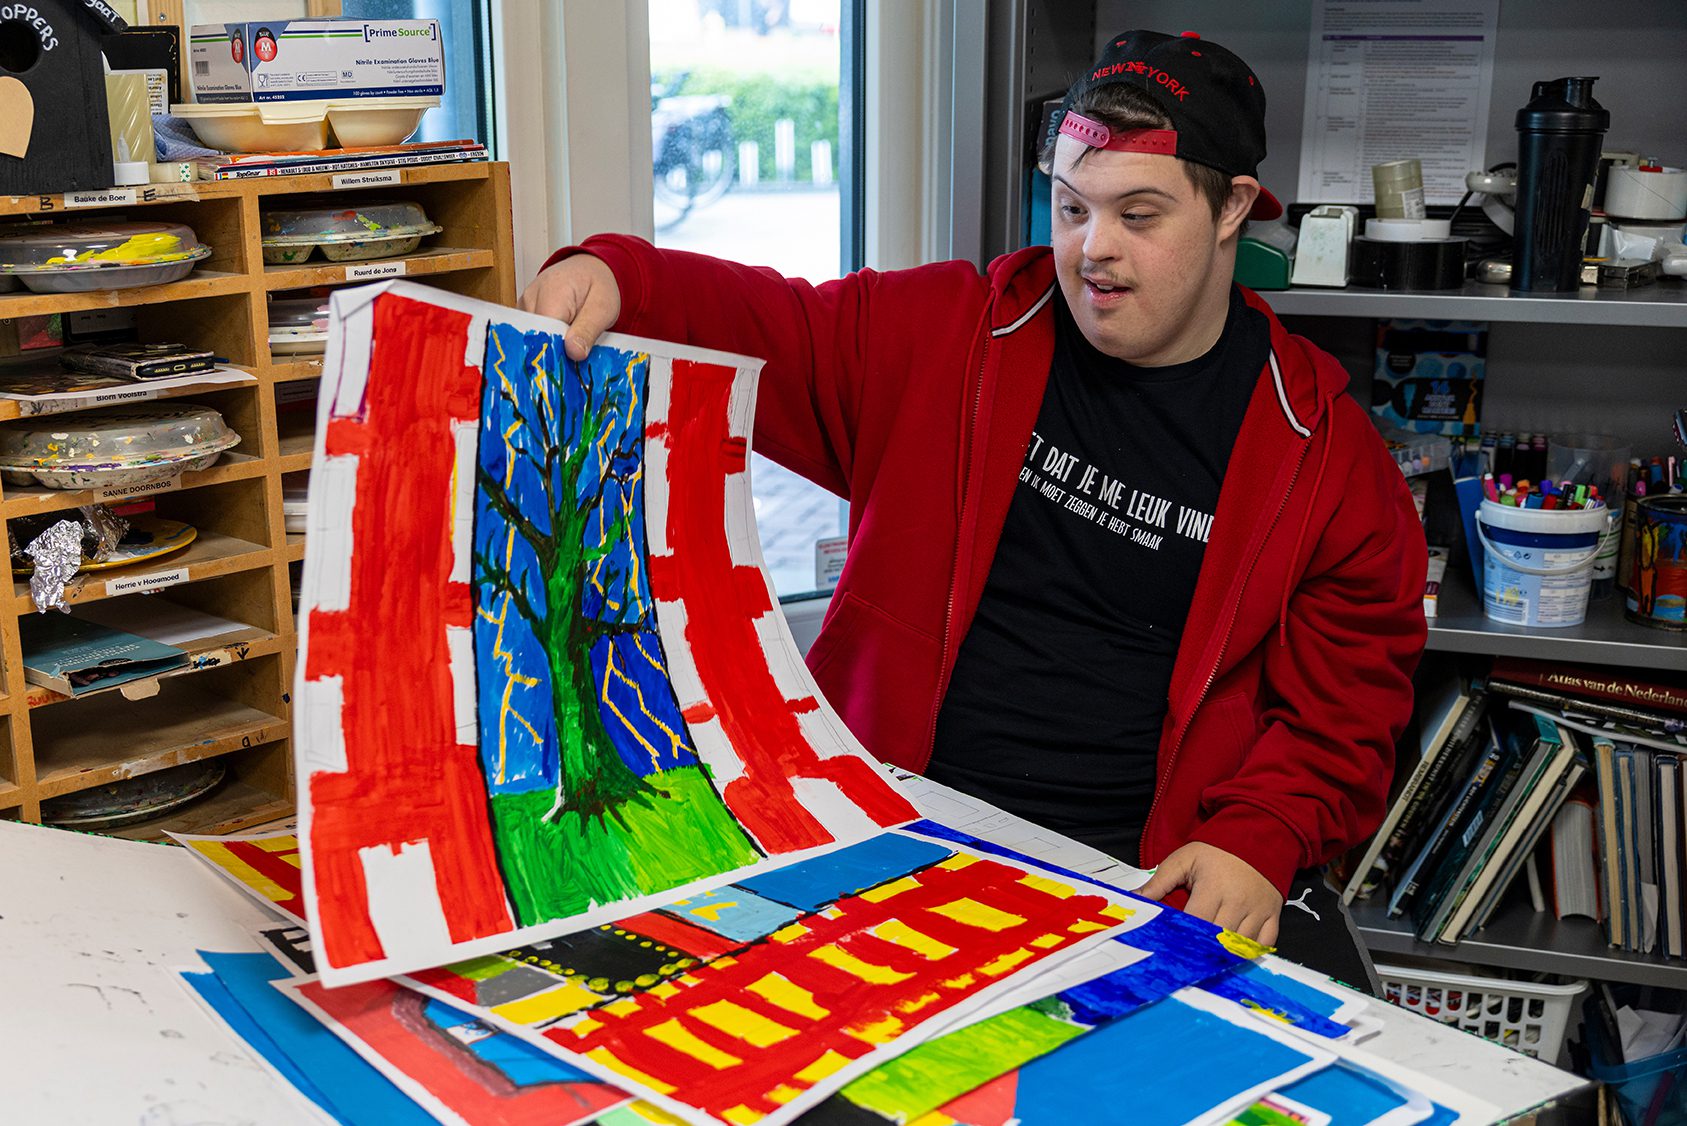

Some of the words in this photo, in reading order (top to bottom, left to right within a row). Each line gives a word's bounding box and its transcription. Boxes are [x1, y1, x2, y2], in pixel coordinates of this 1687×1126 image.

[0, 4, 58, 51] OPPERS
[1092, 63, 1126, 81] NEW
[1148, 66, 1190, 102] YORK
[102, 488, 128, 497] SANNE
[130, 481, 171, 493] DOORNBOS
[1042, 446, 1080, 483] DAT
[1076, 464, 1099, 495] JE
[1098, 475, 1126, 510] ME
[1126, 489, 1172, 528] LEUK
[1019, 466, 1033, 482] EN
[1031, 474, 1041, 489] IK
[1040, 480, 1066, 503] MOET
[1064, 494, 1098, 520] ZEGGEN
[1096, 510, 1107, 526] JE
[1107, 516, 1131, 536] HEBT
[1130, 527, 1163, 551] SMAAK
[115, 582, 136, 590] Herrie
[1584, 680, 1605, 692] van
[1606, 681, 1623, 694] de
